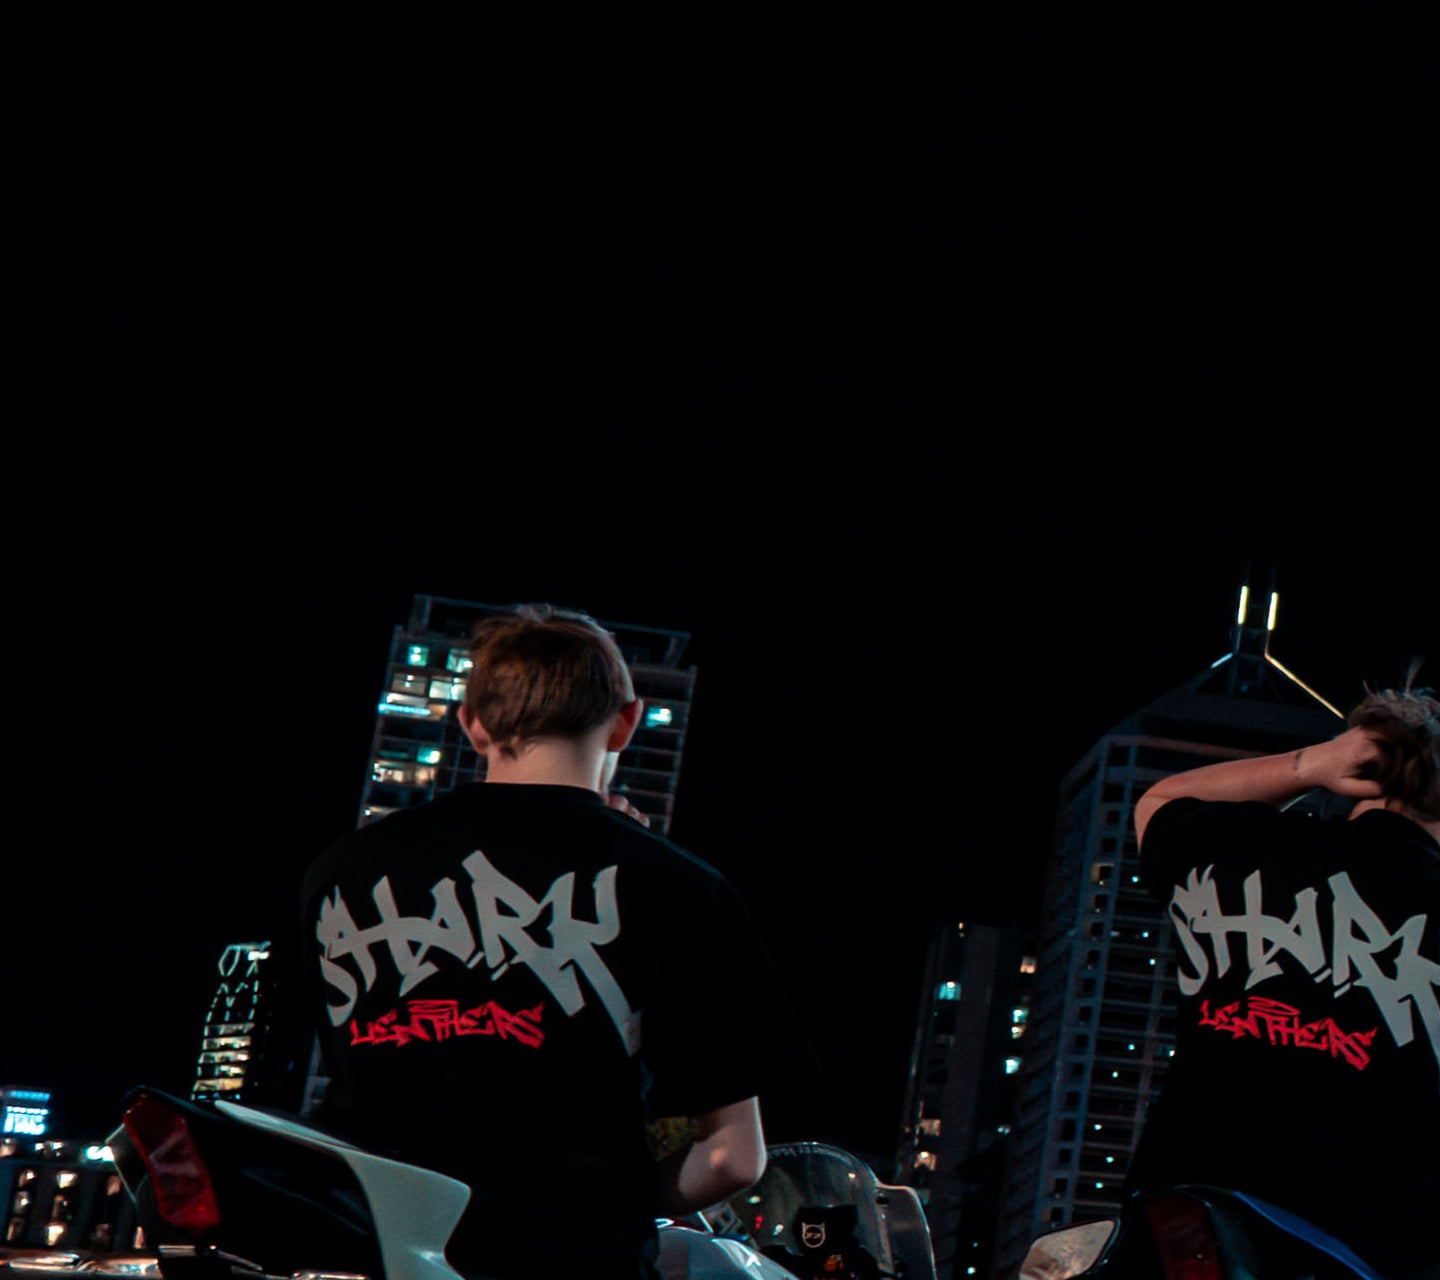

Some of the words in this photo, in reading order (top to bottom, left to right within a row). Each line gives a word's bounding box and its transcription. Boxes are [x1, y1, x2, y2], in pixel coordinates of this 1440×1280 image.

[317, 849, 641, 1056] SHARK
[349, 999, 545, 1049] LEATHERS
[1198, 995, 1379, 1070] LEATHERS
